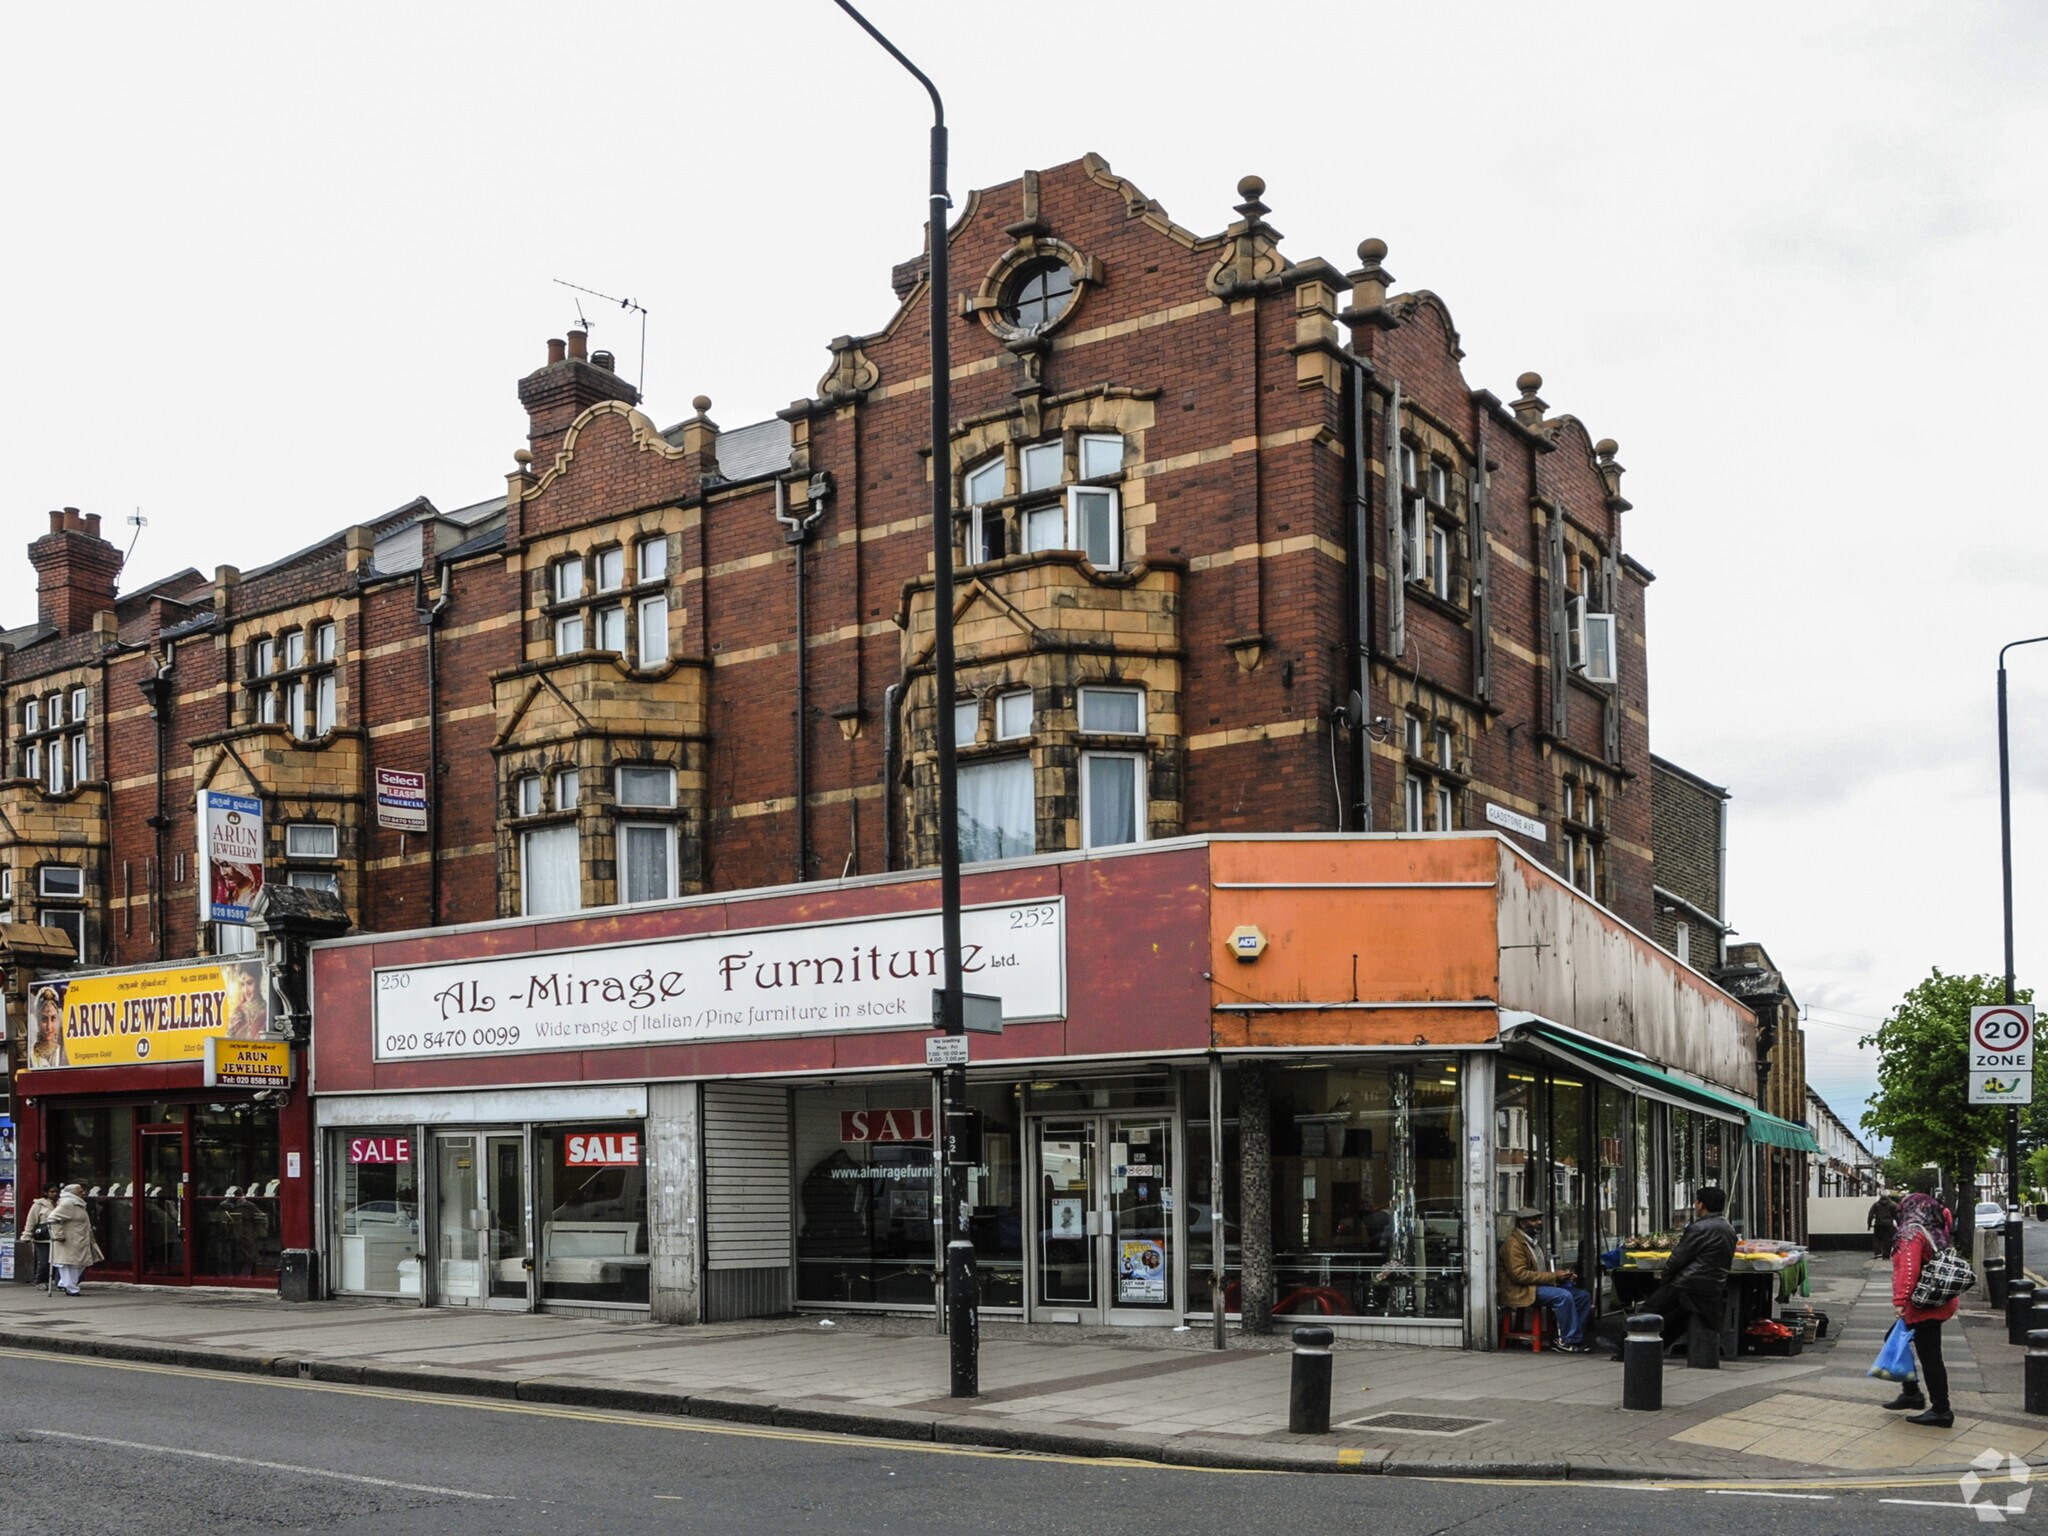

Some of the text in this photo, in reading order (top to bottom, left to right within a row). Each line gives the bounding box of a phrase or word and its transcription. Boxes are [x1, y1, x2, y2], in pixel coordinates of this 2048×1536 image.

[381, 774, 418, 786] Select
[388, 788, 416, 799] LEASE
[380, 797, 424, 808] COMMERCIAL
[213, 824, 257, 845] ARUN
[213, 842, 257, 859] JEWELLERY
[212, 907, 226, 916] 020
[1010, 907, 1055, 930] 252
[1238, 937, 1257, 947] ADT
[719, 944, 986, 992] Furniture
[991, 954, 1020, 968] Ltd.
[381, 974, 410, 990] 250
[66, 991, 226, 1038] ARUN JEWELLERY
[535, 1021, 571, 1037] Wide
[575, 1020, 618, 1036] range
[623, 1015, 637, 1034] of
[748, 1005, 828, 1026] furniture
[834, 1003, 850, 1018] in
[856, 998, 907, 1017] stock
[386, 1025, 520, 1052] 020 8470 0099
[1984, 1021, 2022, 1039] 20
[237, 1052, 267, 1061] ARUN
[1976, 1055, 2026, 1066] ZONE
[222, 1064, 282, 1074] JEWELLERY
[851, 1109, 949, 1141] SAL
[352, 1139, 409, 1161] SALE
[569, 1136, 638, 1163] SALE
